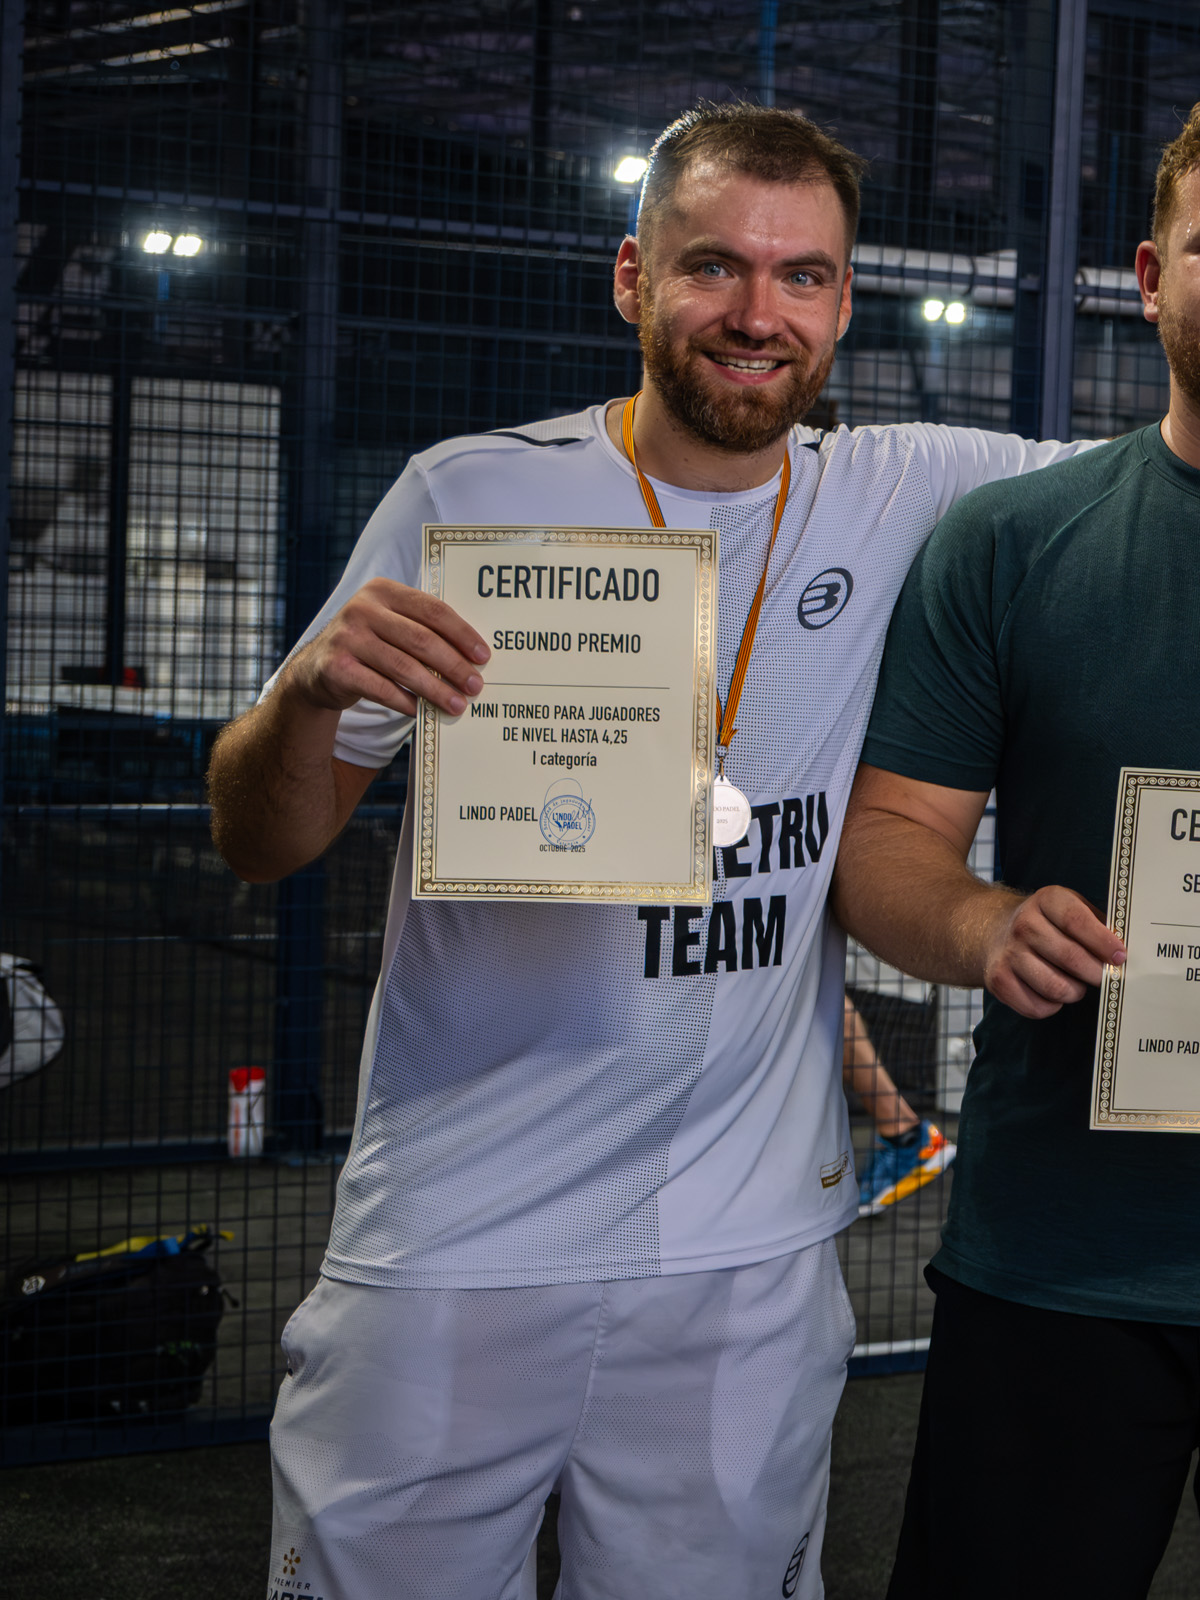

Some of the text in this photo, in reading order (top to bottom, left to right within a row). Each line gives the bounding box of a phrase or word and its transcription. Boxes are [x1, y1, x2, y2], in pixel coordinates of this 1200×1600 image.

[477, 564, 660, 602] CERTIFICADO
[493, 630, 642, 654] SEGUNDO PREMIO
[471, 702, 661, 722] MINI TORNEO PARA JUGADORES
[503, 727, 628, 745] DE NIVEL HASTA 4,25
[540, 751, 598, 770] categoría
[459, 805, 496, 821] LINDO
[500, 806, 538, 822] PADEL
[539, 844, 567, 852] OCTUBRE
[637, 895, 787, 979] TEAM
[1157, 943, 1184, 959] MINI
[1138, 1038, 1174, 1053] LINDO
